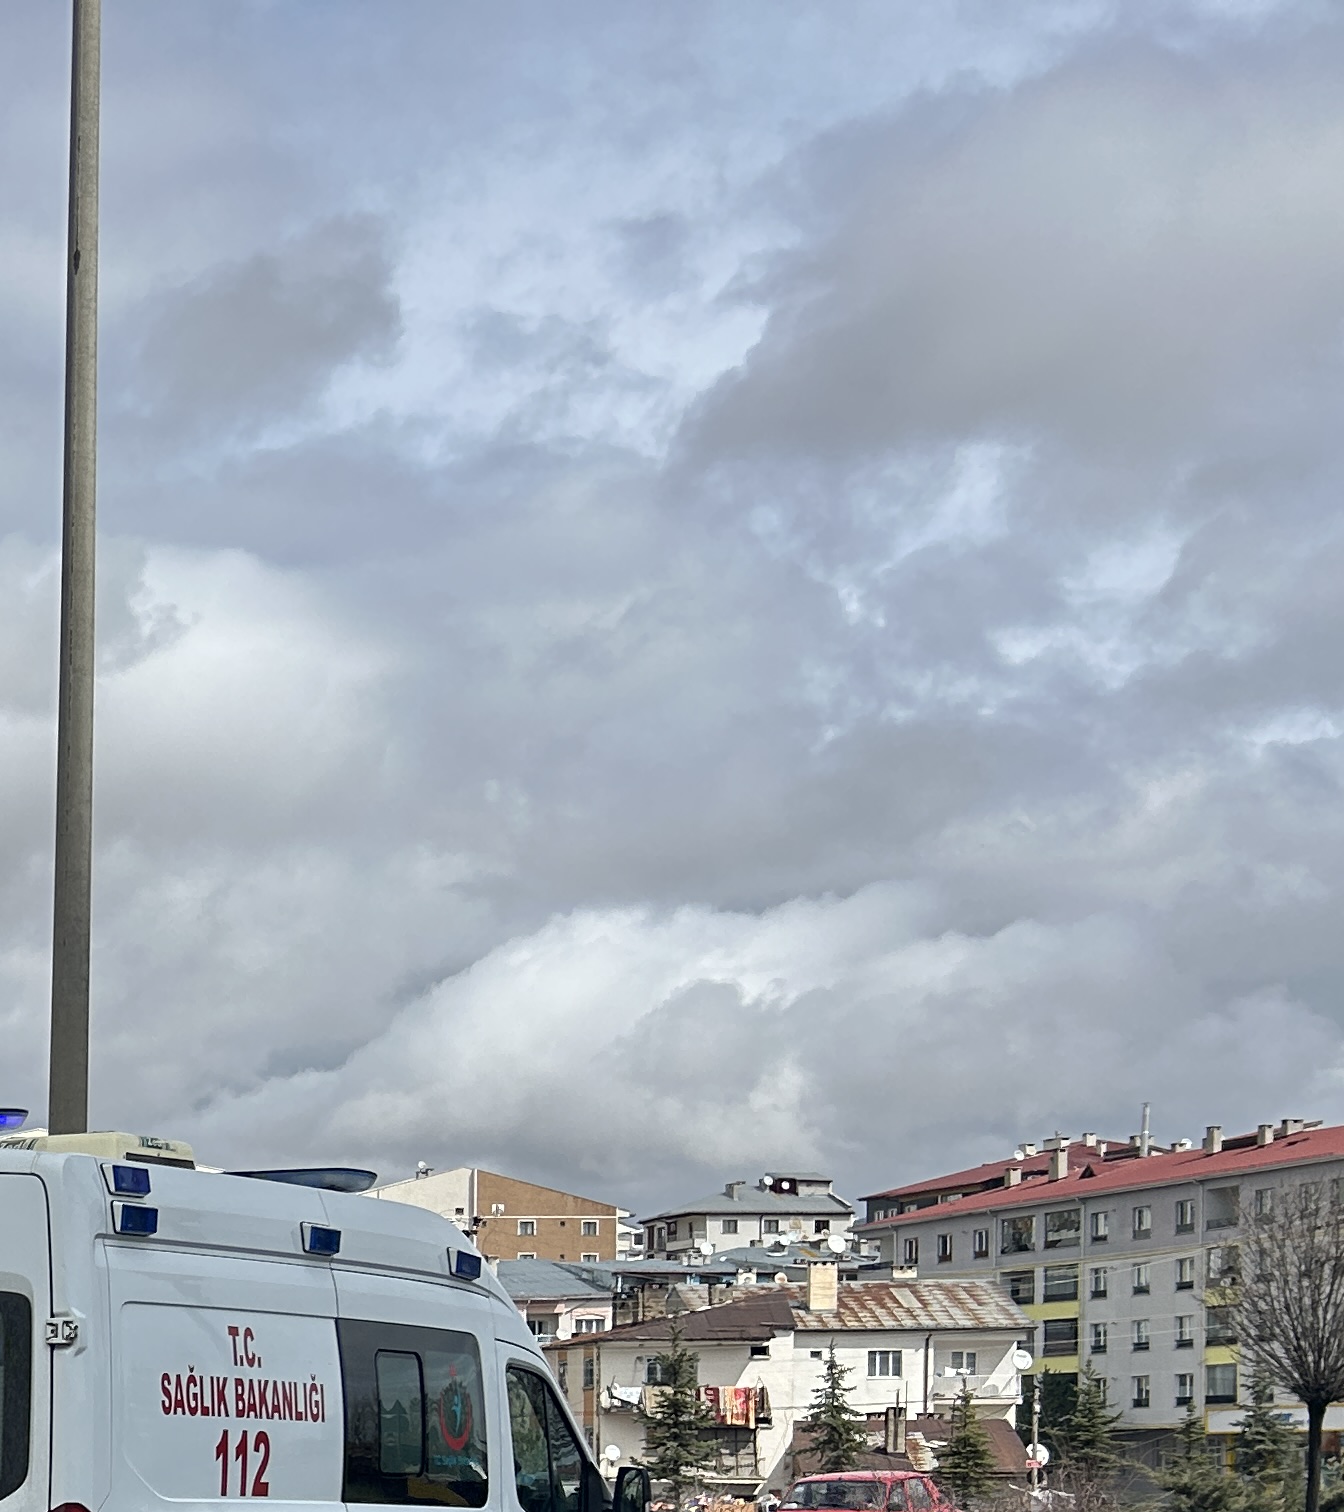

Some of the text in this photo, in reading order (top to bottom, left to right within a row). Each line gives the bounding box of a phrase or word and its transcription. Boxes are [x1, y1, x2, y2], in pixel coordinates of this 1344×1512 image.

[227, 1325, 262, 1369] T.C.
[161, 1364, 326, 1423] SAĞLIK BAKANLIĞI
[215, 1428, 271, 1497] 112
